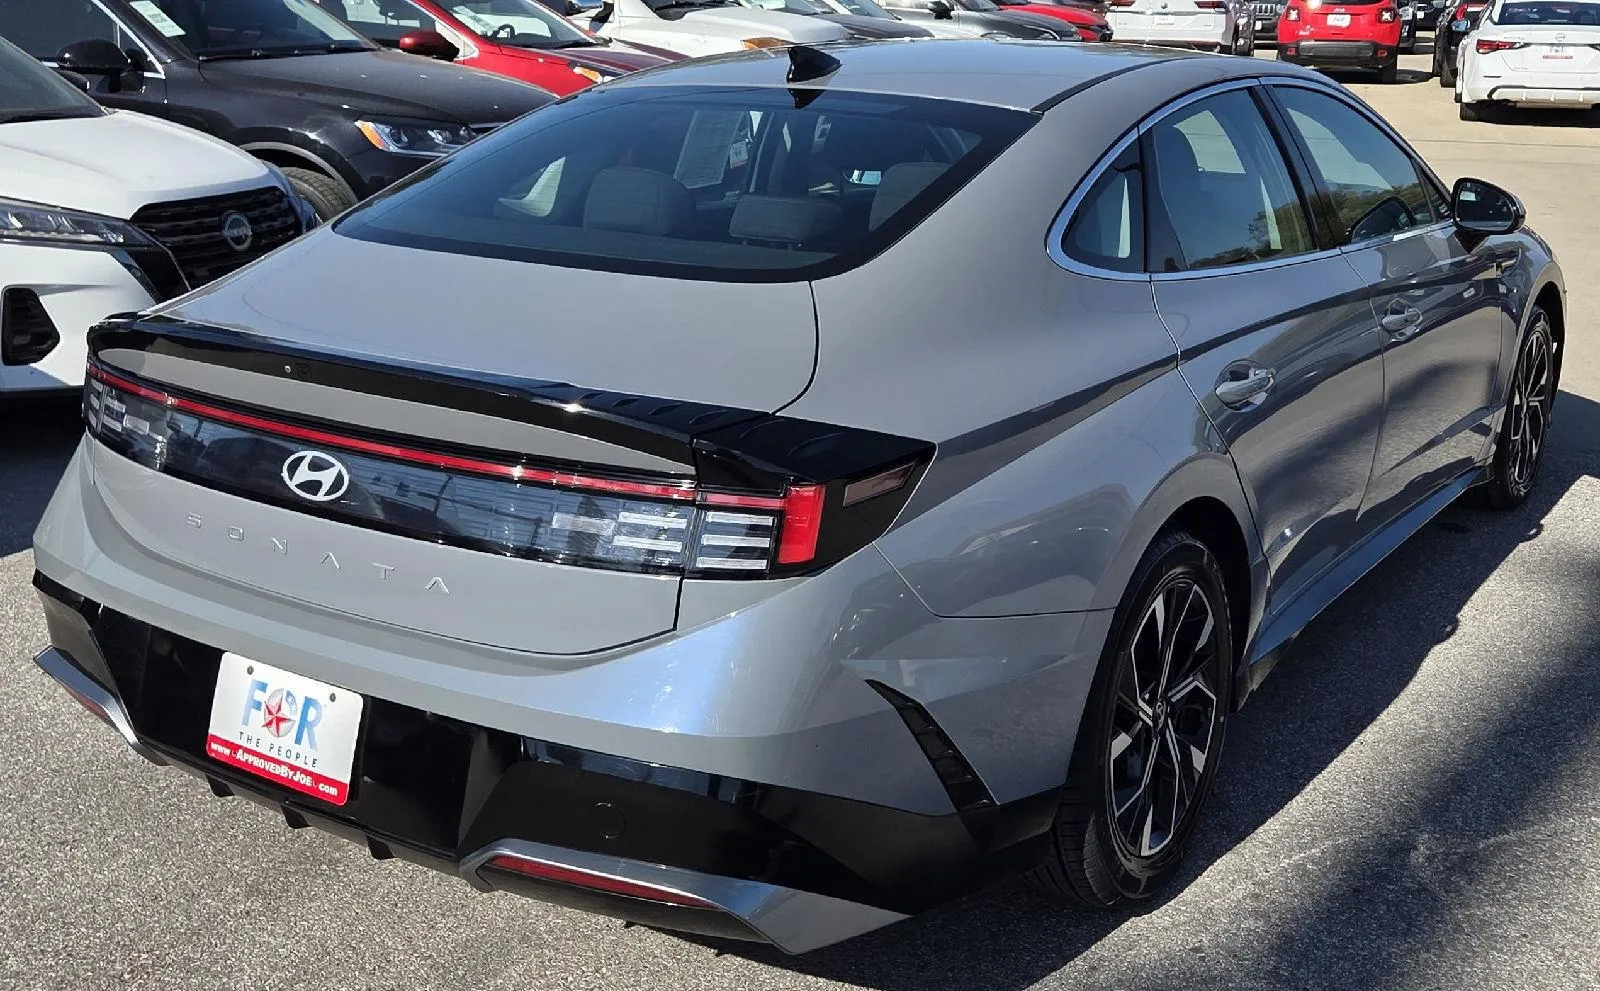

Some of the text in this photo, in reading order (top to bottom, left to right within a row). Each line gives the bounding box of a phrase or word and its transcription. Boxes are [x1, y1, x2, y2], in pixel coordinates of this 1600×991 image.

[187, 512, 449, 594] SONATA
[239, 731, 318, 768] THE PEOPLE
